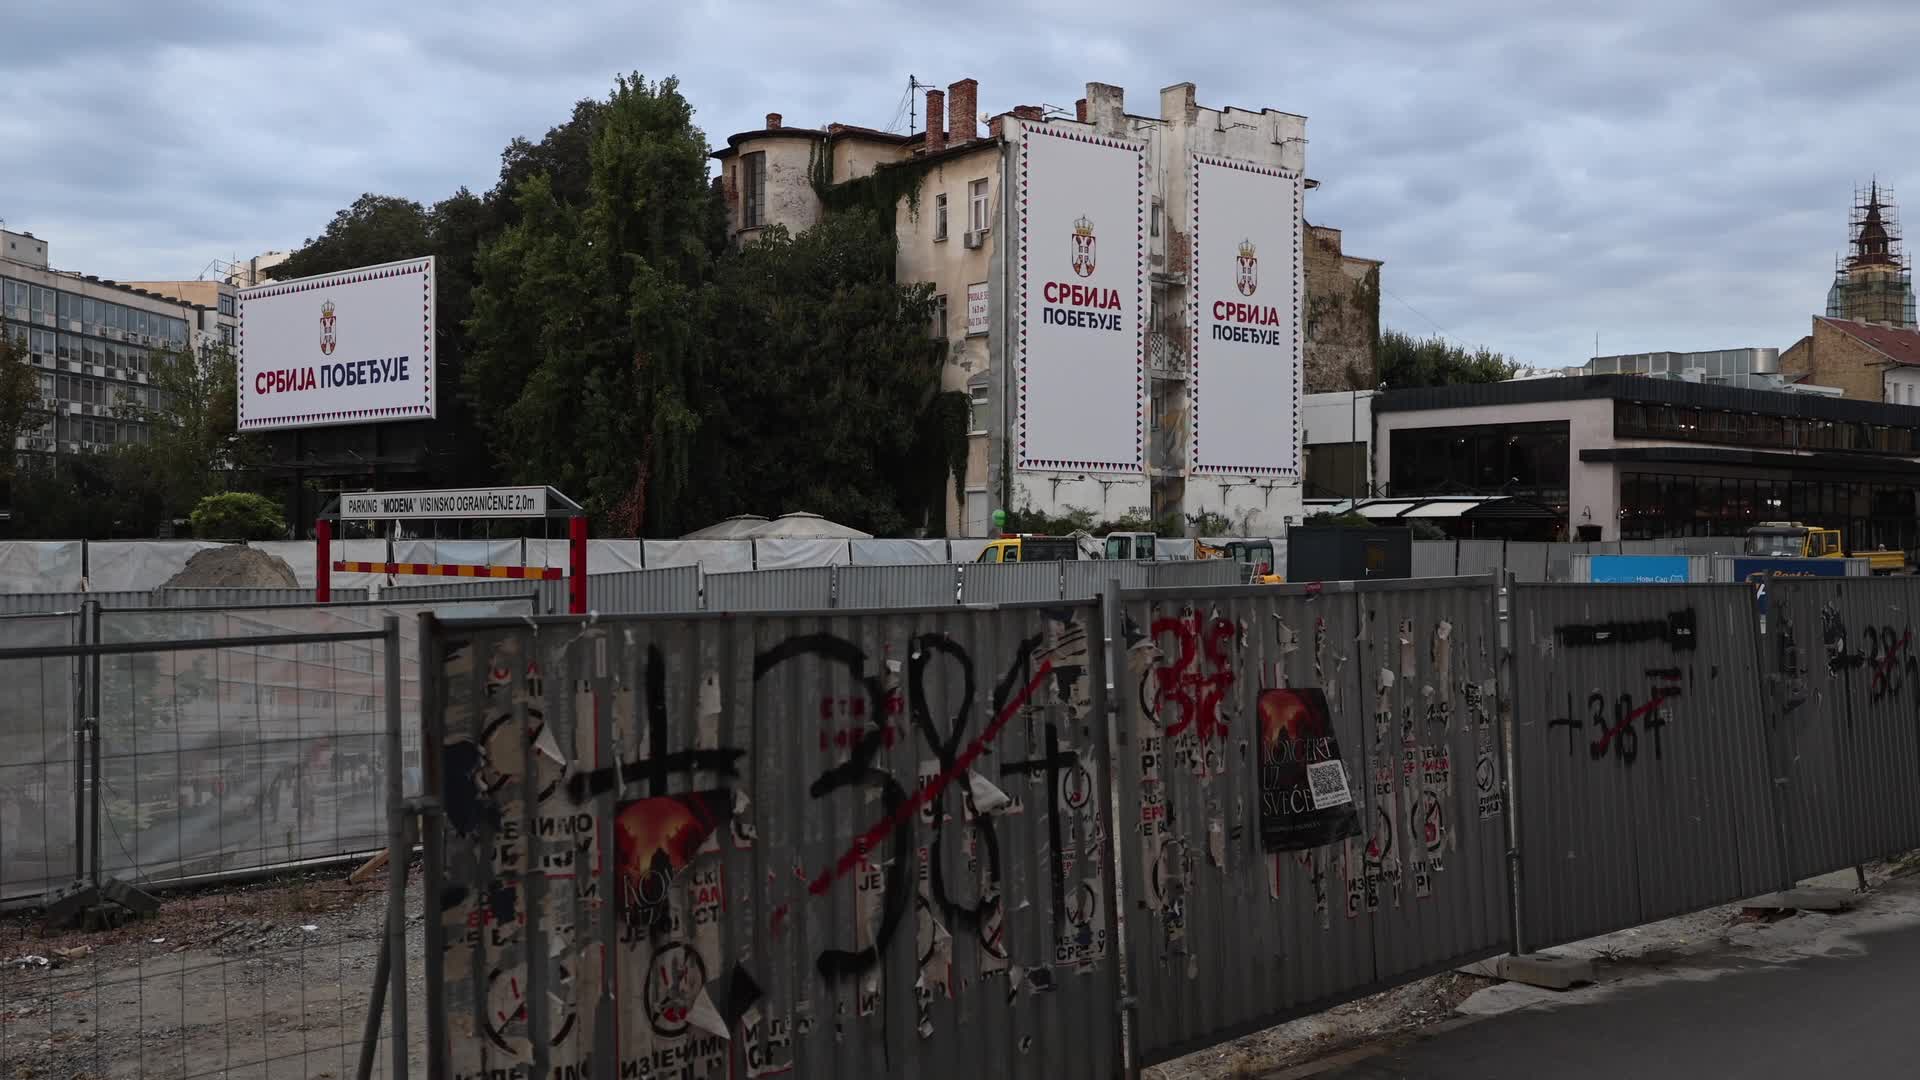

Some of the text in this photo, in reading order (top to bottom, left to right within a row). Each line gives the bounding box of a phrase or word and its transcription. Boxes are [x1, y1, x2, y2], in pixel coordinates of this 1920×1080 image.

[1043, 281, 1121, 310] СРБИЈА
[1043, 307, 1121, 331] ПОБЕЂУЈЕ
[1213, 300, 1280, 327] СРБИЈА
[1213, 324, 1280, 346] ПОБЕЂУЈЕ
[255, 355, 410, 395] СРБИЈА ПОБЕЂУЈЕ
[348, 499, 377, 513] PARKING
[419, 495, 455, 512] VISINSKO
[456, 492, 514, 511] OGRANIČENJE
[515, 494, 535, 512] 2,0m
[1636, 575, 1653, 583] Нови
[1263, 736, 1332, 766] KONCERT
